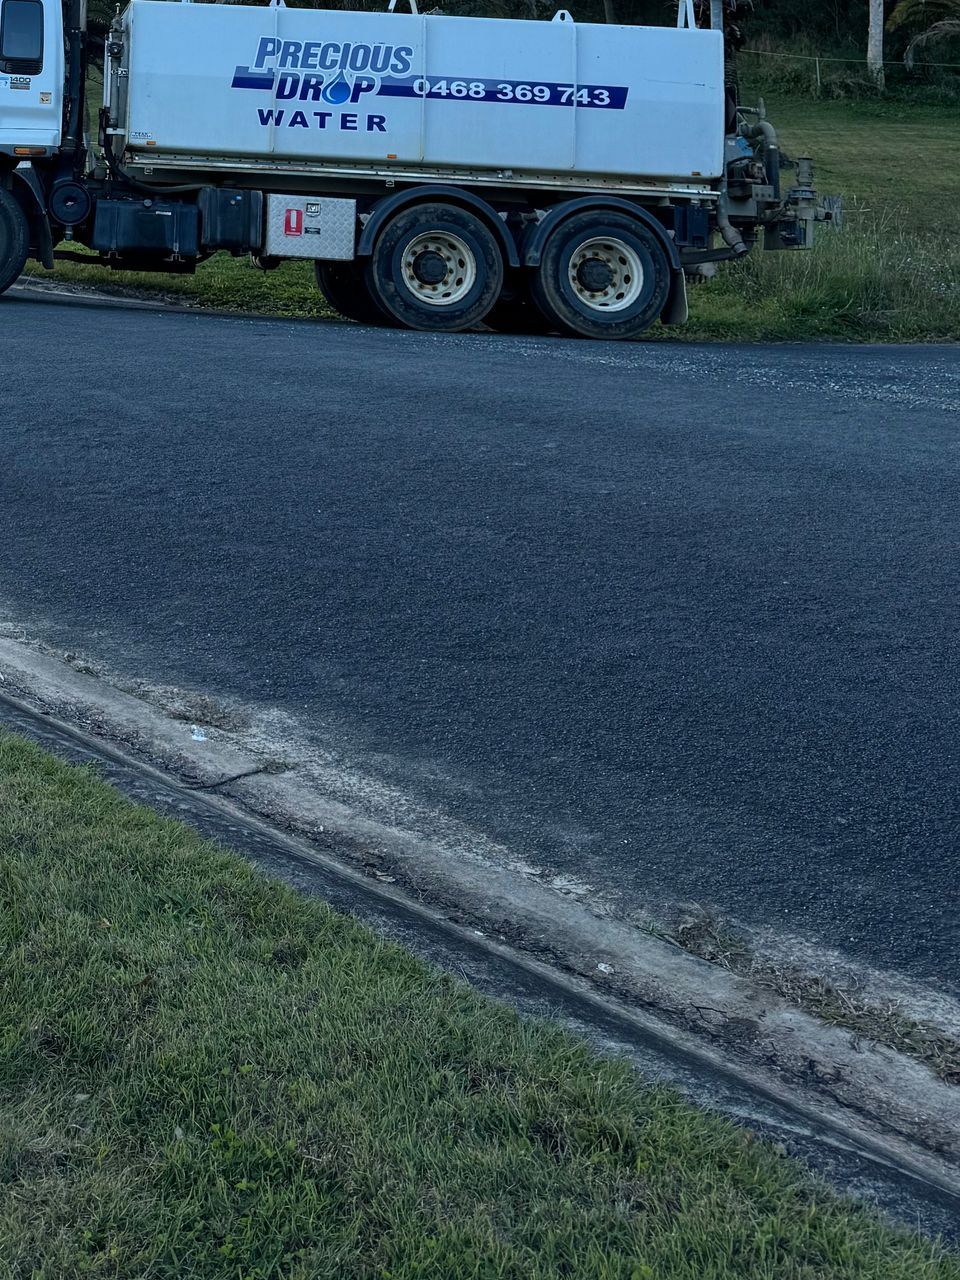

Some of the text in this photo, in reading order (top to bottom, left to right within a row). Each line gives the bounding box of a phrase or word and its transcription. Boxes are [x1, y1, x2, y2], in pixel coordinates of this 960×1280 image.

[254, 36, 413, 74] PRECIOUS
[275, 70, 376, 104] DROP
[412, 78, 611, 106] 0468 369 743
[257, 109, 388, 132] WATER
